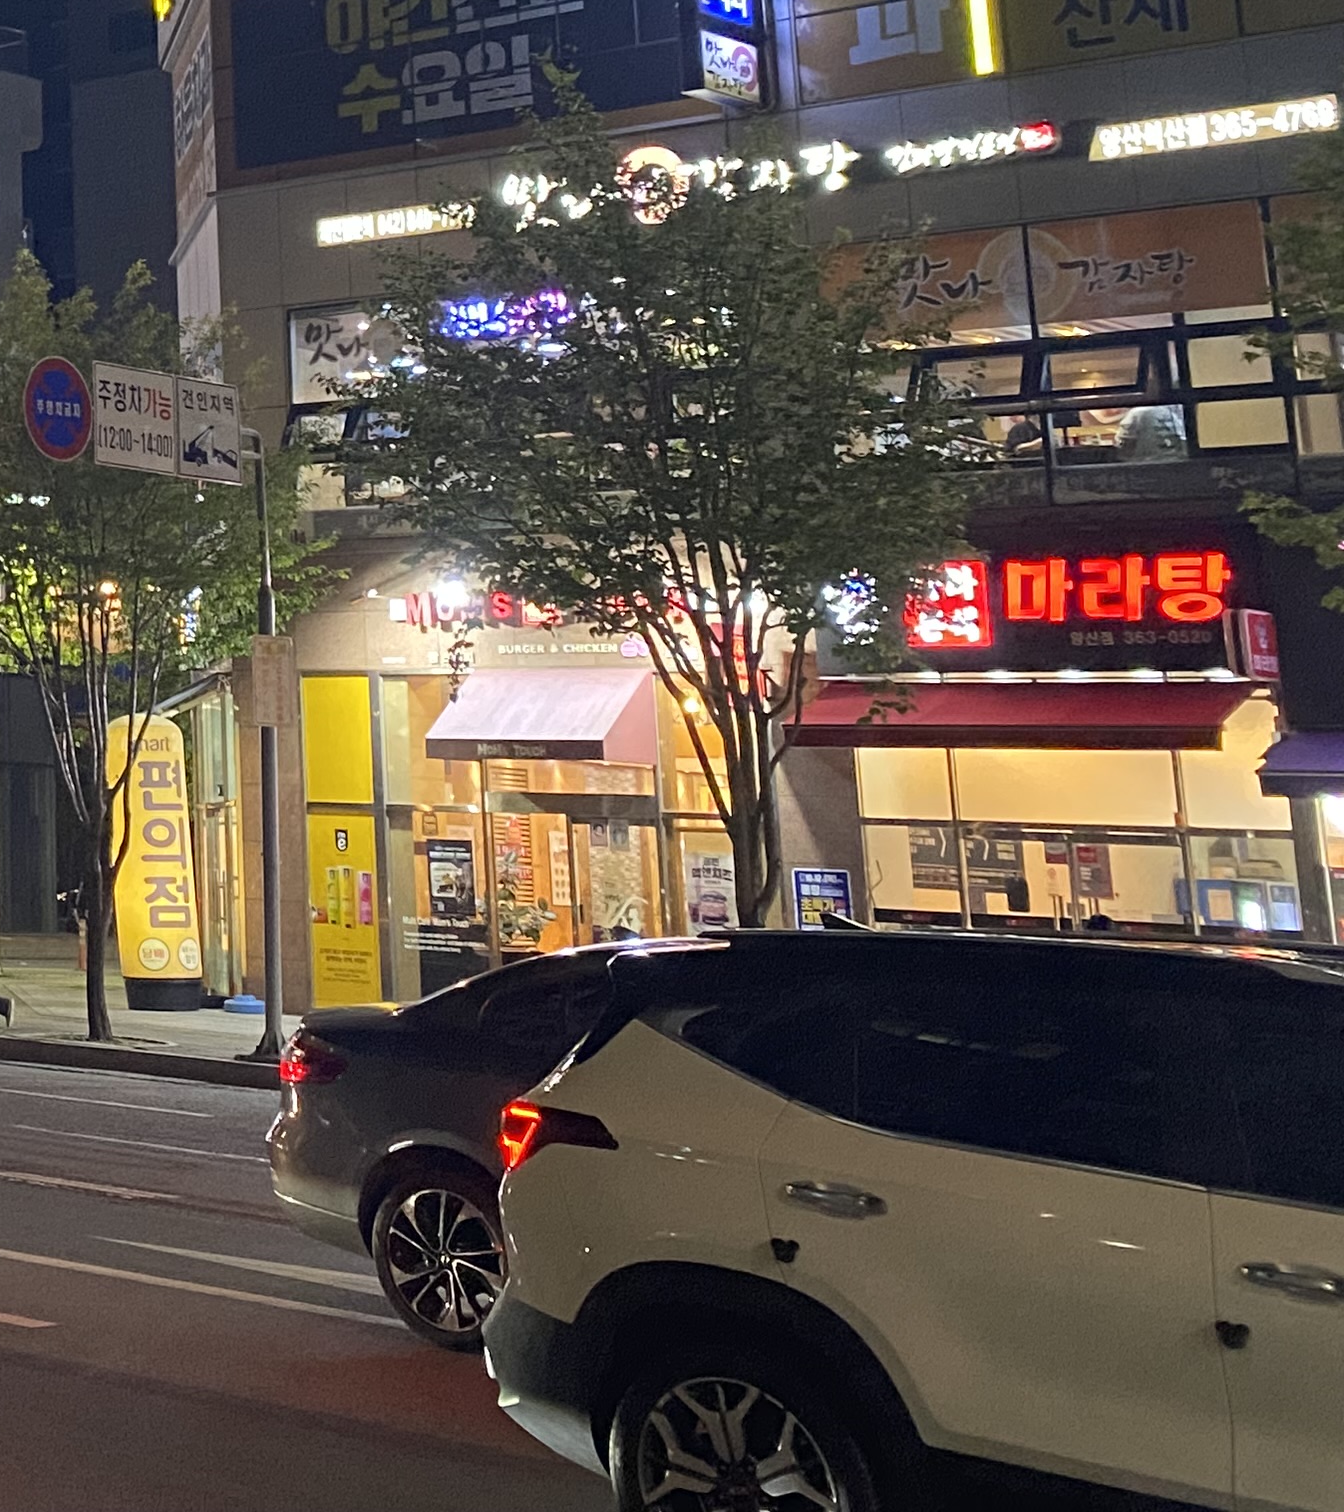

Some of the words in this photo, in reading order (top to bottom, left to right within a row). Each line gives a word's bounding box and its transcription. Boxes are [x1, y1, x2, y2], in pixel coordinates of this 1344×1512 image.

[336, 33, 535, 133] 수요일
[1057, 248, 1196, 290] 감자탕
[98, 379, 173, 421] 주정차가능
[181, 389, 235, 417] 견인지역
[1004, 552, 1232, 623] 마라탕
[498, 644, 545, 655] BURGER
[562, 642, 618, 654] CHICKEN
[137, 759, 192, 928] 편의점
